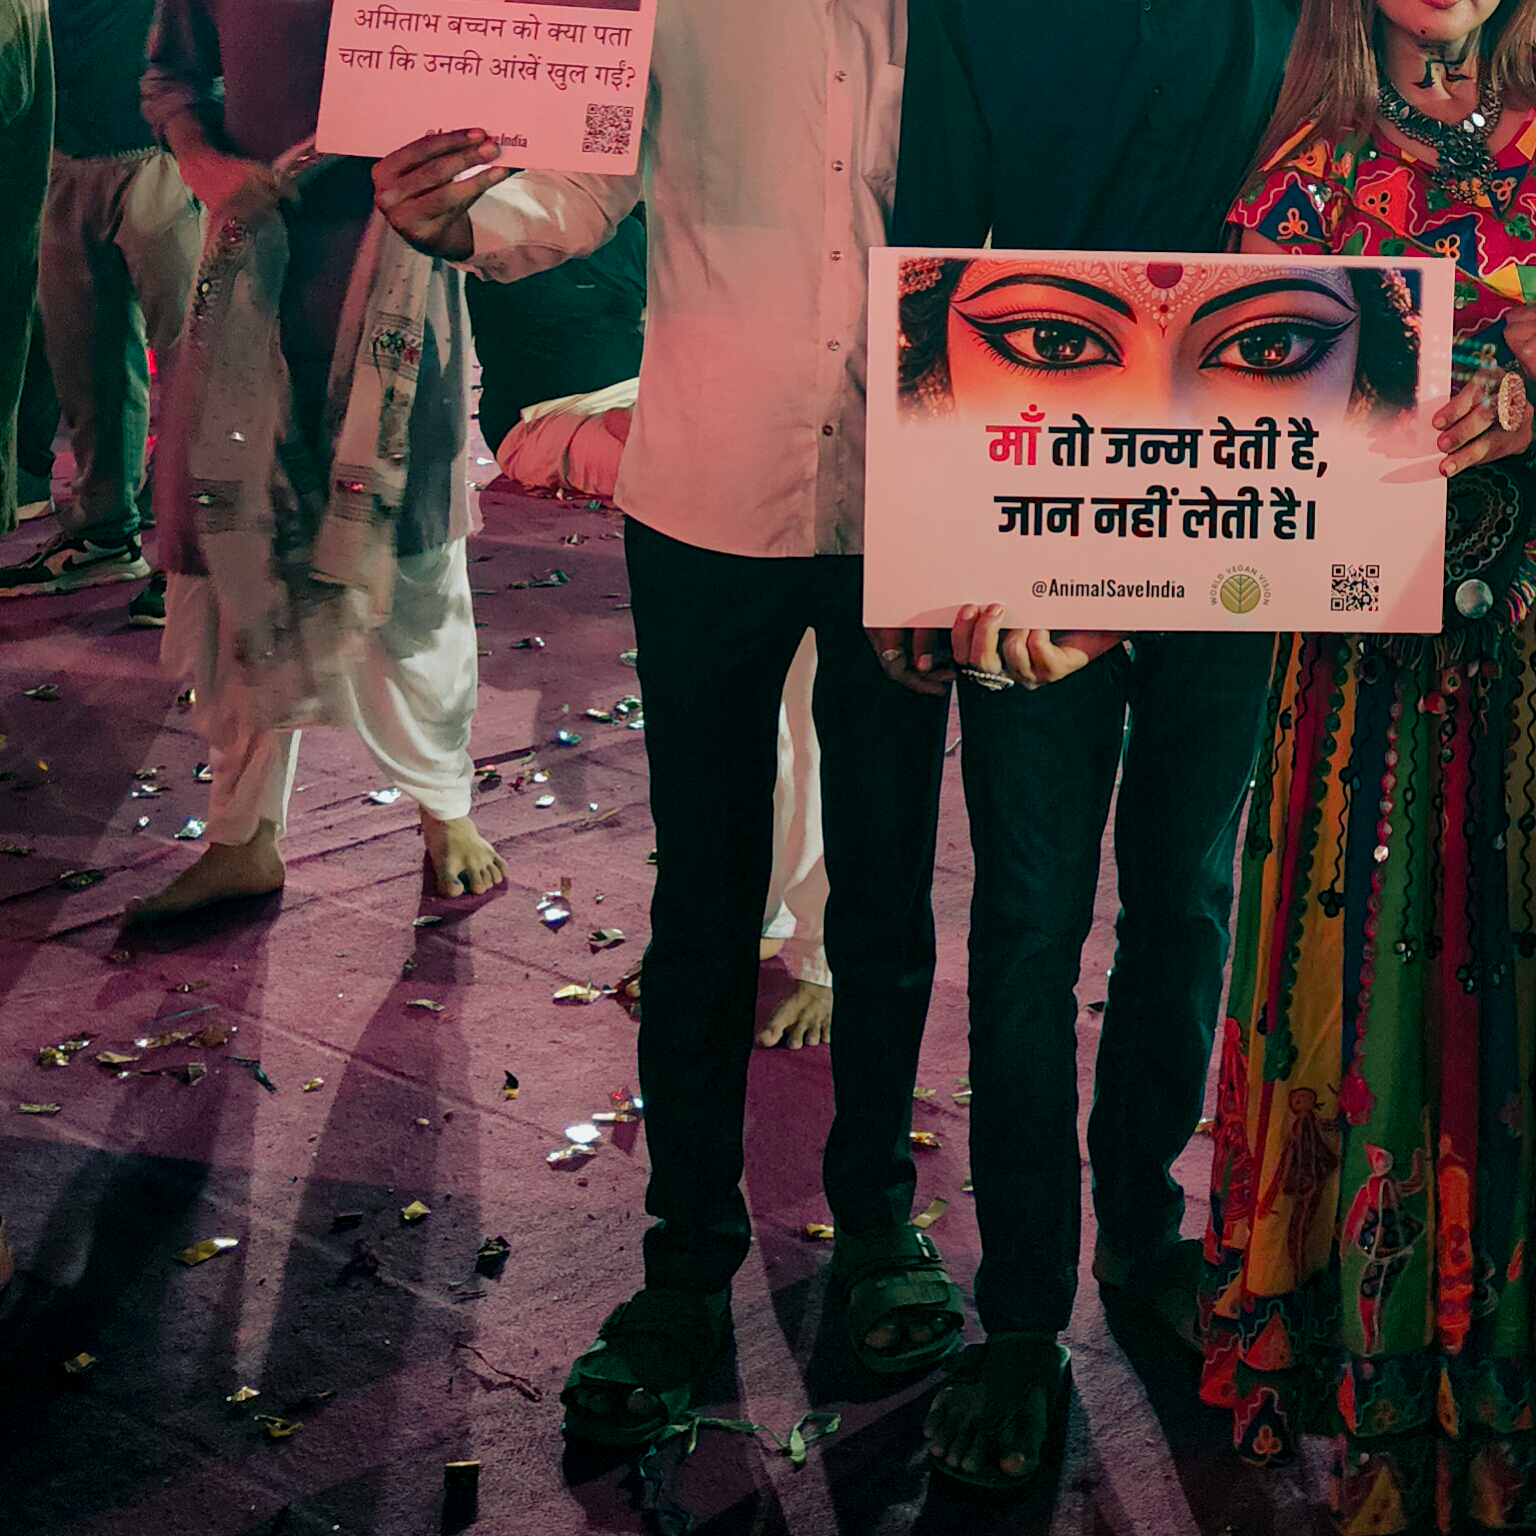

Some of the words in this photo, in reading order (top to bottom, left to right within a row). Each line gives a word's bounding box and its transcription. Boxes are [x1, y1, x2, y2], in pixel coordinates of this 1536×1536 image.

[354, 5, 441, 33] अमिताभ
[447, 15, 506, 39] बच्चन
[512, 14, 540, 40] को
[547, 22, 587, 44] क्या
[593, 25, 632, 47] पता
[339, 47, 382, 70] चला
[389, 46, 418, 71] कि
[423, 50, 483, 76] उनकी
[489, 53, 542, 81] आंखें
[547, 61, 589, 91] खुल
[985, 404, 1046, 466] माँ
[1048, 413, 1094, 467] तो
[1101, 426, 1204, 469] जन्म
[1209, 416, 1281, 470] देती
[1287, 417, 1329, 479] है,
[994, 495, 1085, 537] जान
[1091, 485, 1180, 539] नहीं
[1179, 486, 1264, 540] लेती
[1031, 578, 1186, 600] @AnimalSaveIndia
[1210, 573, 1225, 606] WORLD
[1225, 565, 1258, 576] VEGAN
[1259, 573, 1272, 606] VISION
